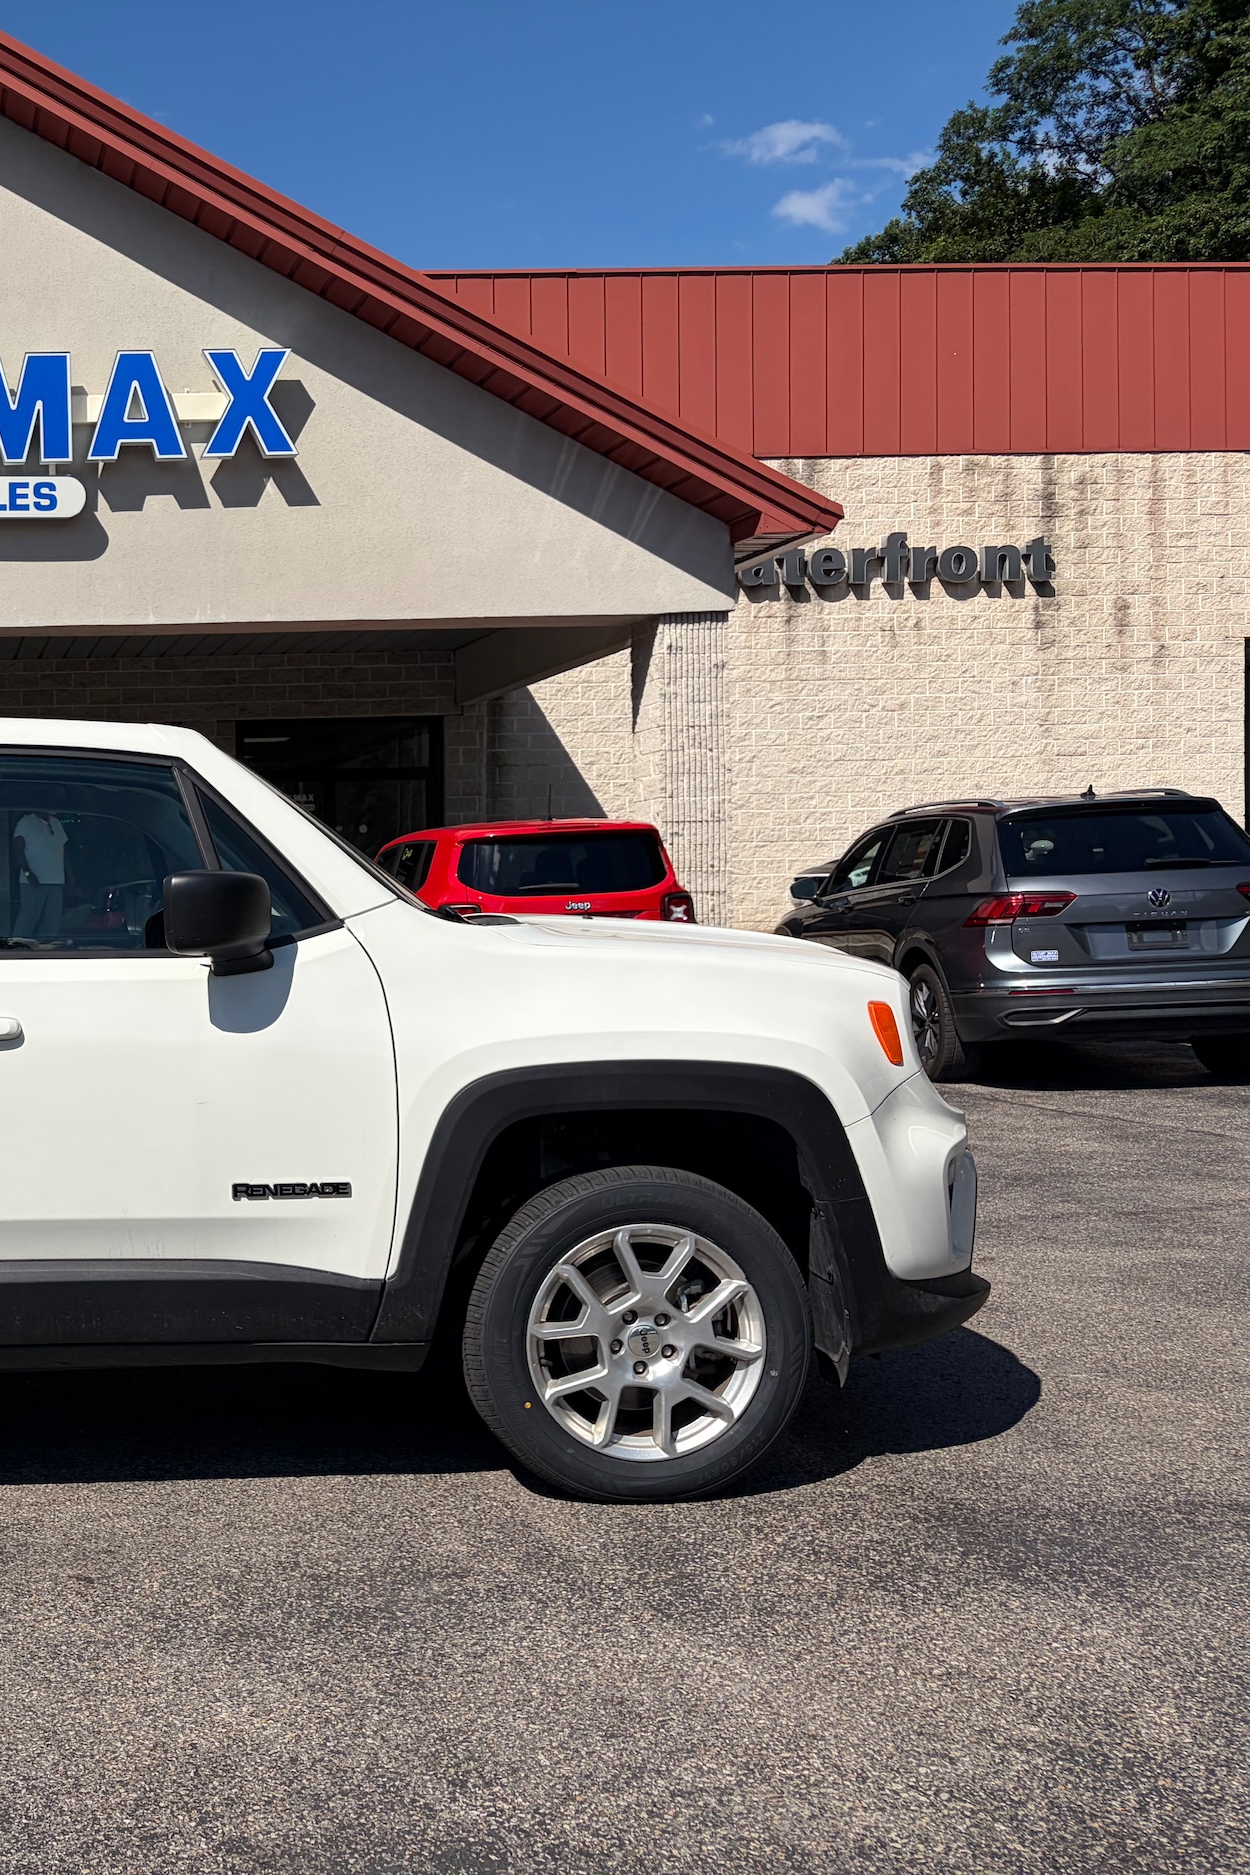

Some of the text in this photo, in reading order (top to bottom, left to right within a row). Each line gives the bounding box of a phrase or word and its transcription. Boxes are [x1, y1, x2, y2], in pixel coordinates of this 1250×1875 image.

[739, 532, 1053, 586] aterfront
[565, 901, 591, 910] Jeep
[232, 1182, 352, 1200] RENEGADE
[639, 1329, 651, 1354] Jeep
